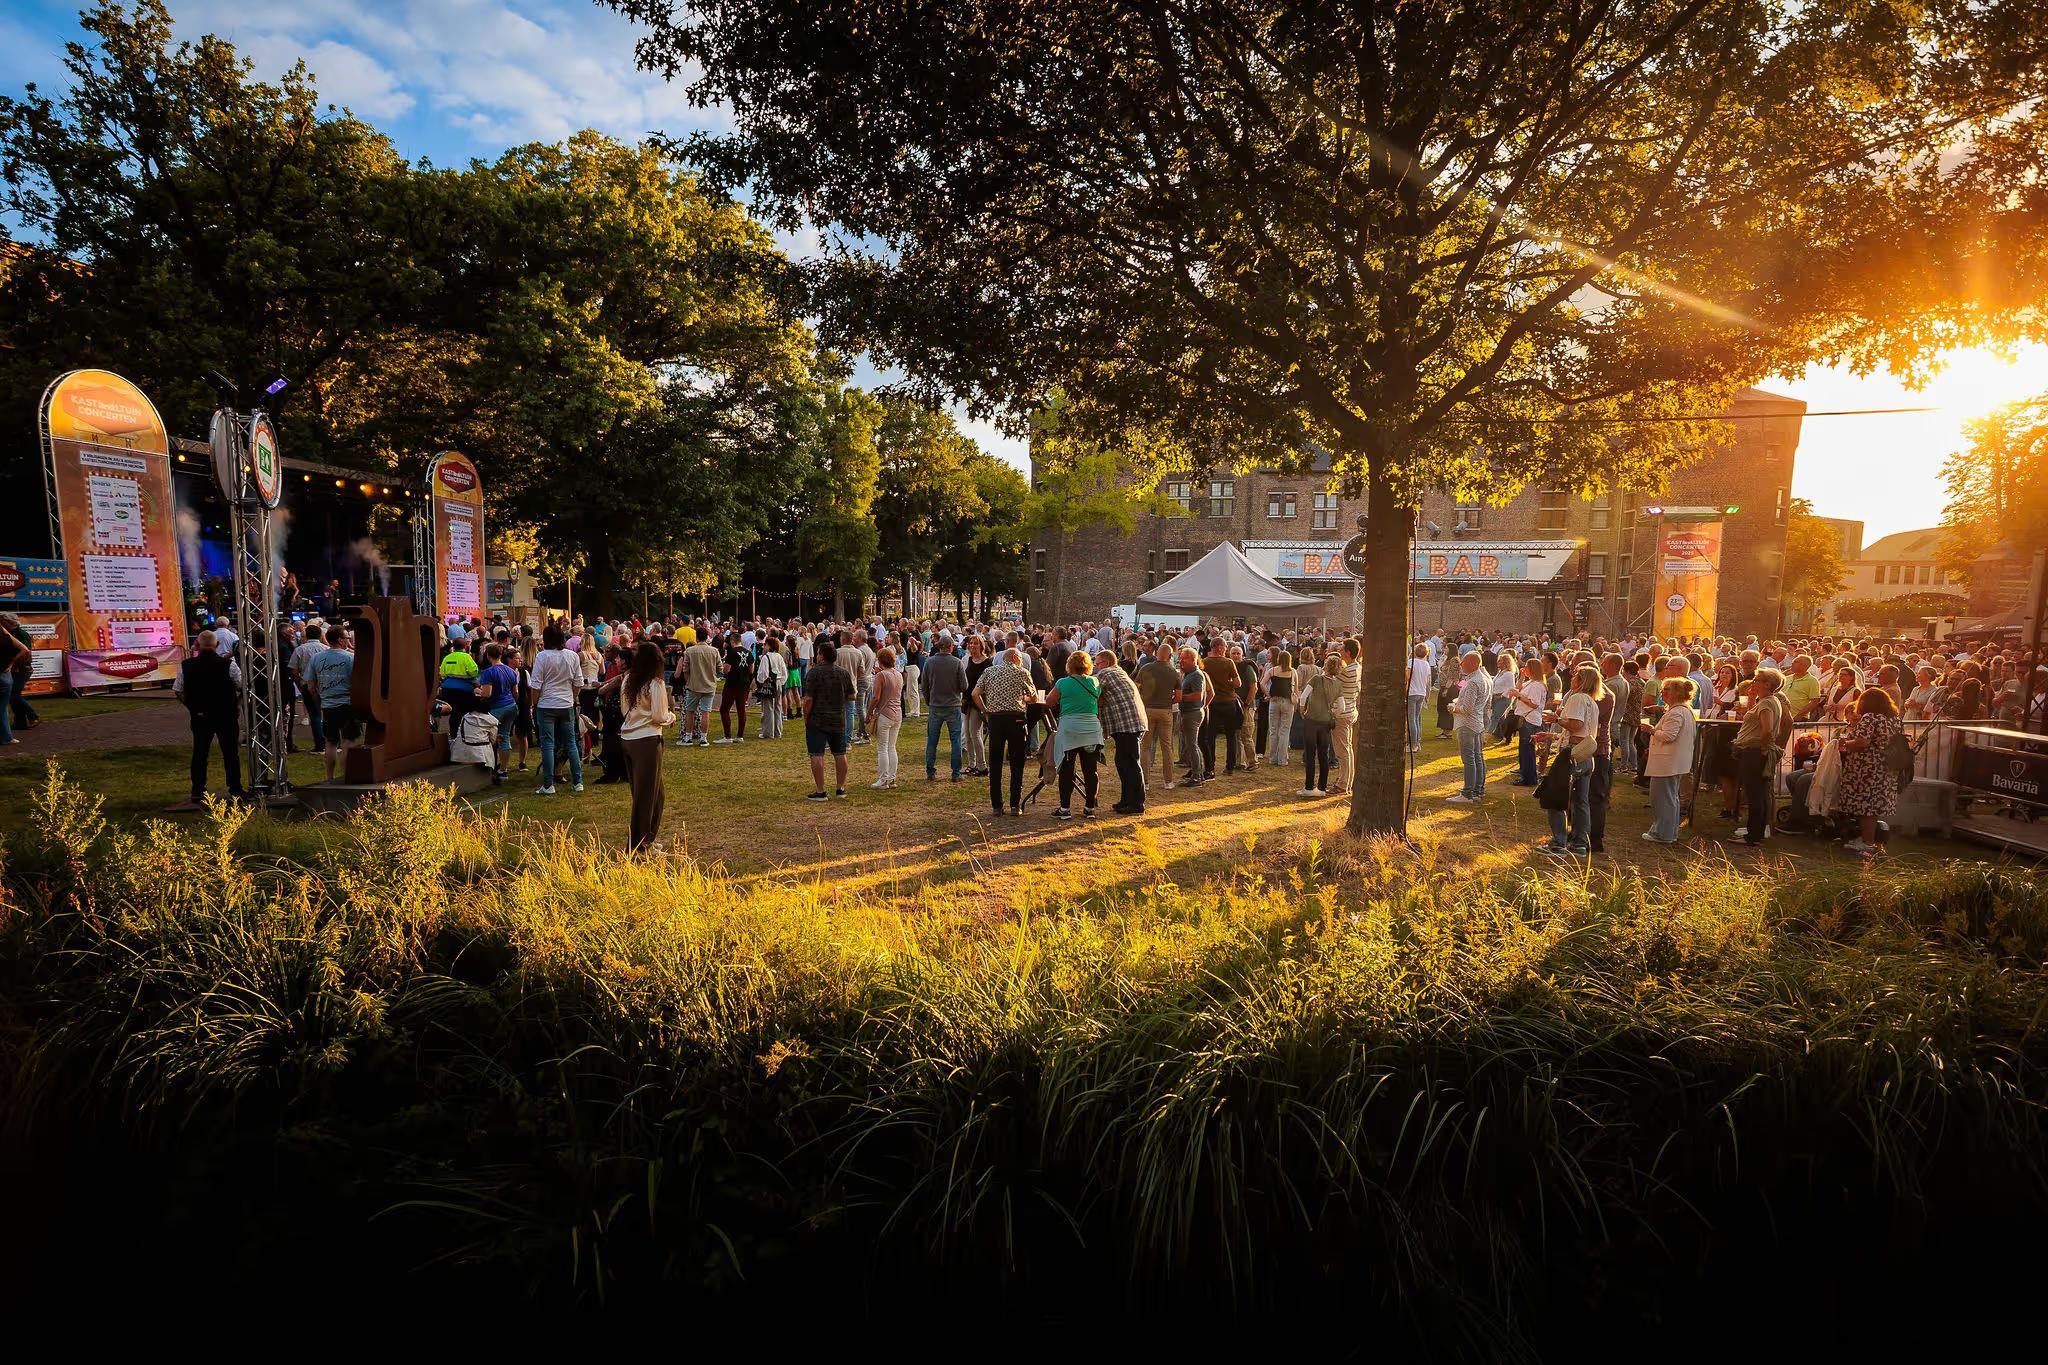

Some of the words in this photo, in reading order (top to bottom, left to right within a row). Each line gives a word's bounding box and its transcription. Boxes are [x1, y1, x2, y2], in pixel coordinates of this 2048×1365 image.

[78, 406, 137, 424] CONCERTEN
[444, 475, 470, 485] CONCERTEN
[1304, 553, 1345, 575] BA
[1349, 554, 1366, 563] Am
[1429, 554, 1499, 577] BAR
[1992, 774, 2038, 795] Bavaria
